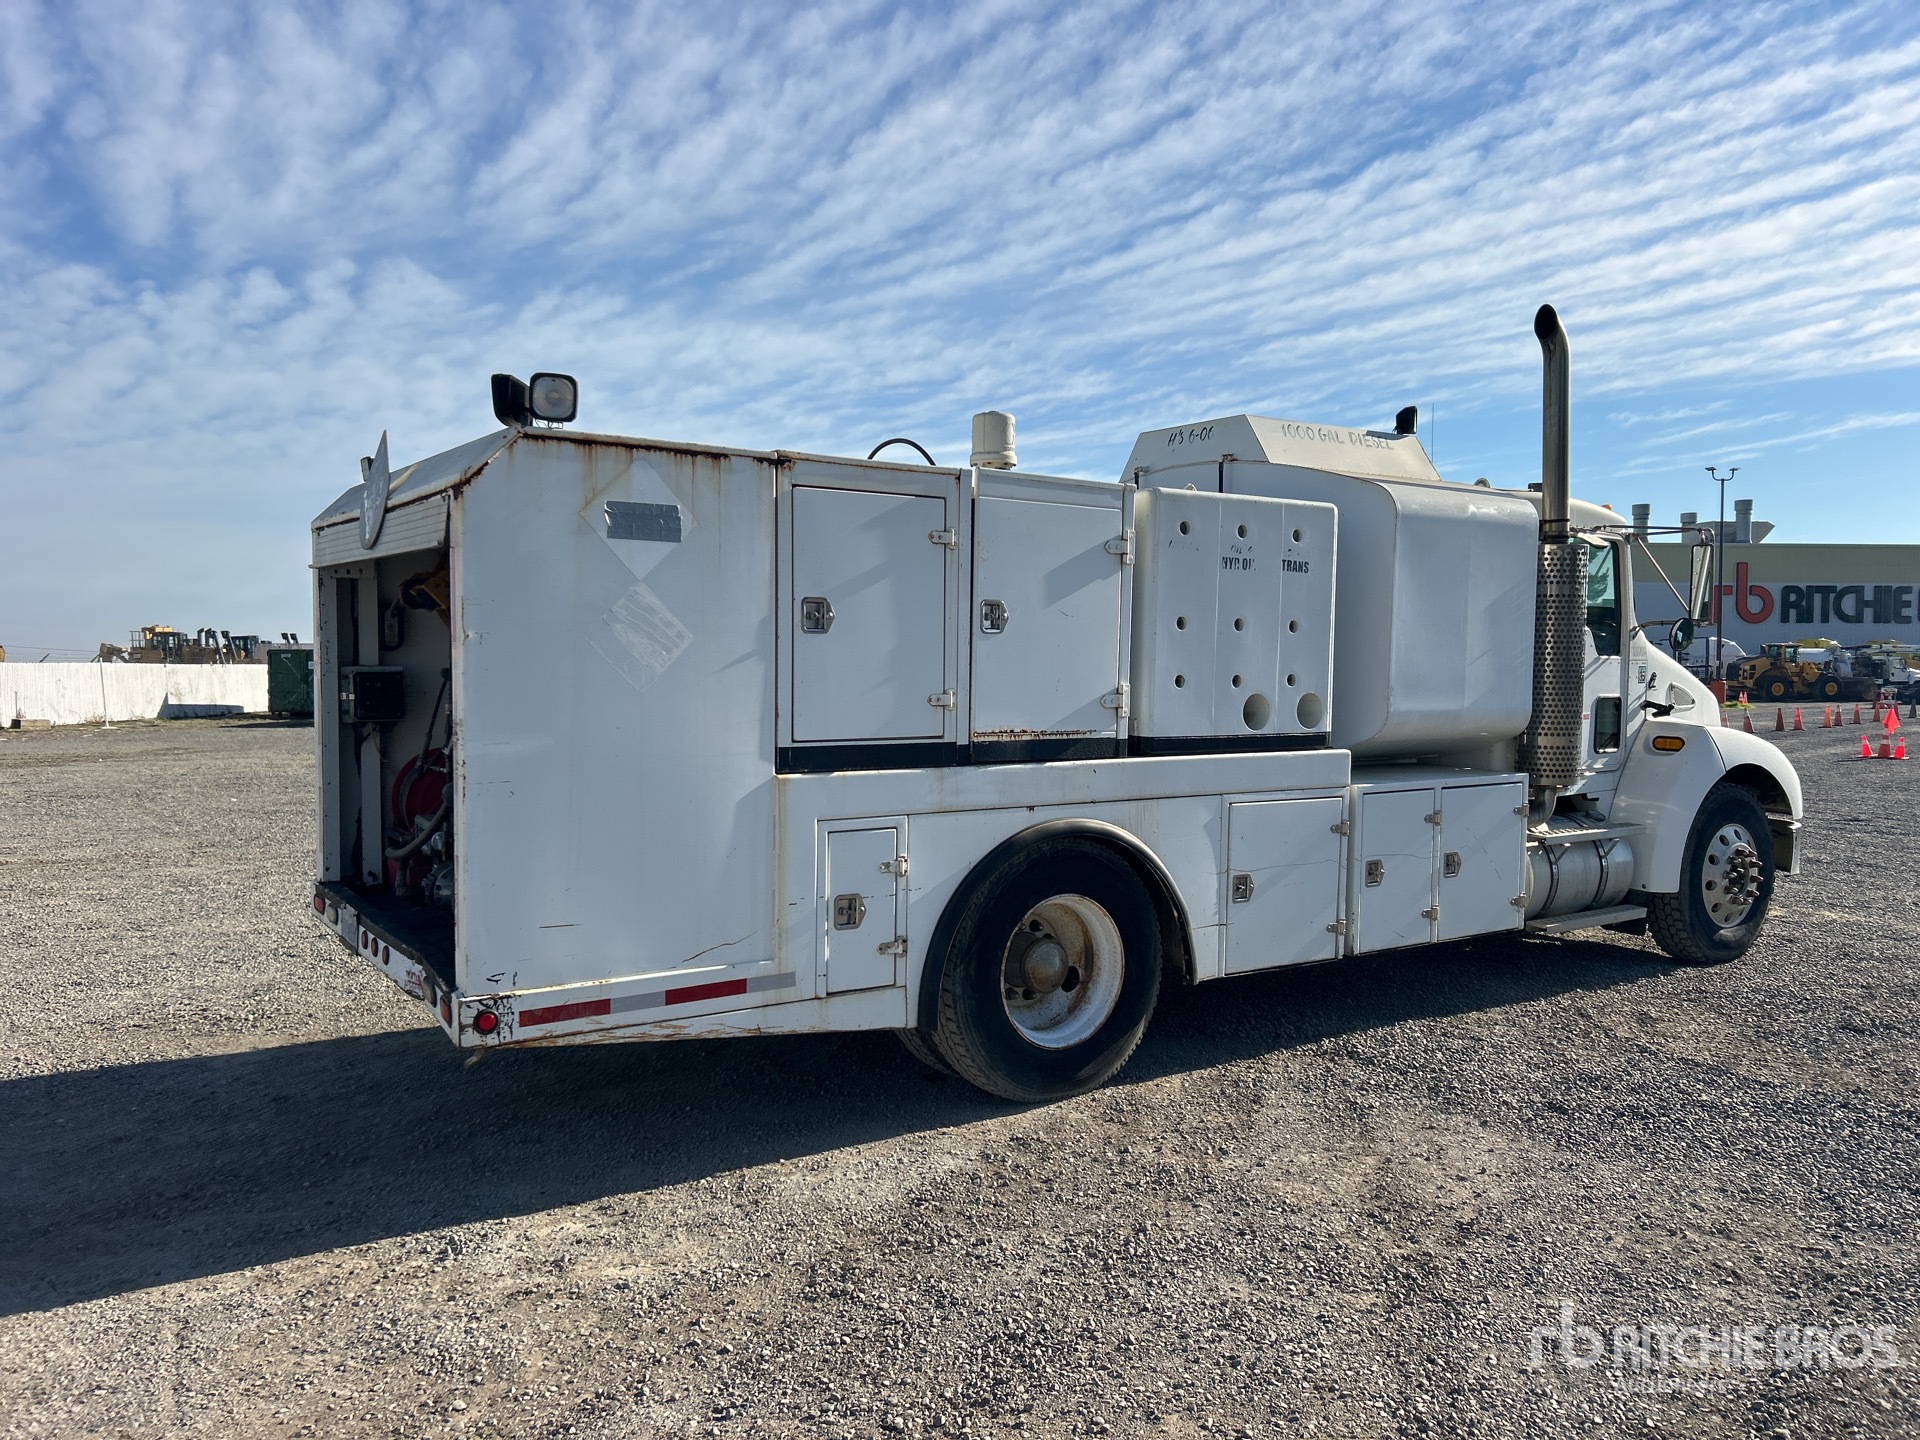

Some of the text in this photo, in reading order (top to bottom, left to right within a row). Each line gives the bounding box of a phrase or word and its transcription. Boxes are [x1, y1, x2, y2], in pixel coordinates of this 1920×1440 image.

[1281, 423, 1395, 451] 1000 GAL DIESEL
[1281, 559, 1310, 574] TRANS
[1780, 585, 1913, 624] RITCHIE
